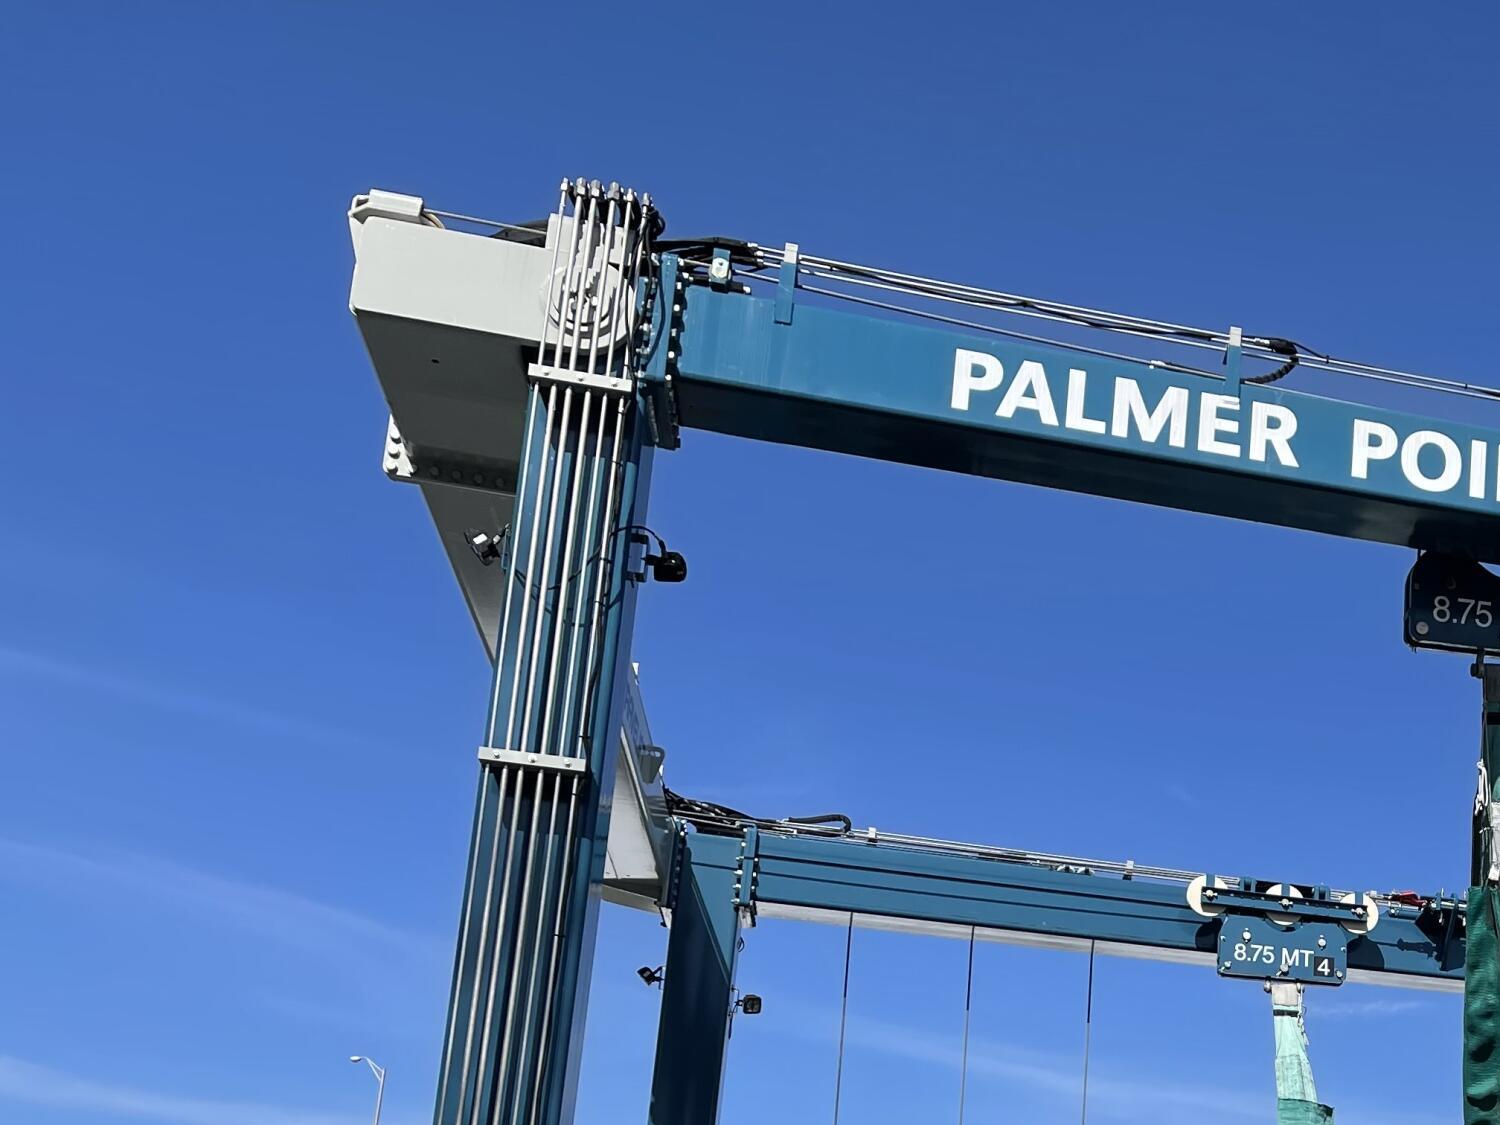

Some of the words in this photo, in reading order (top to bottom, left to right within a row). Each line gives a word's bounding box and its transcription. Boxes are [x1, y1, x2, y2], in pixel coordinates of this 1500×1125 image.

[950, 347, 1300, 468] PALMER
[1432, 595, 1493, 628] 8.75
[1233, 943, 1275, 964] 8.75
[1281, 947, 1315, 968] MT
[1317, 958, 1331, 976] 4
